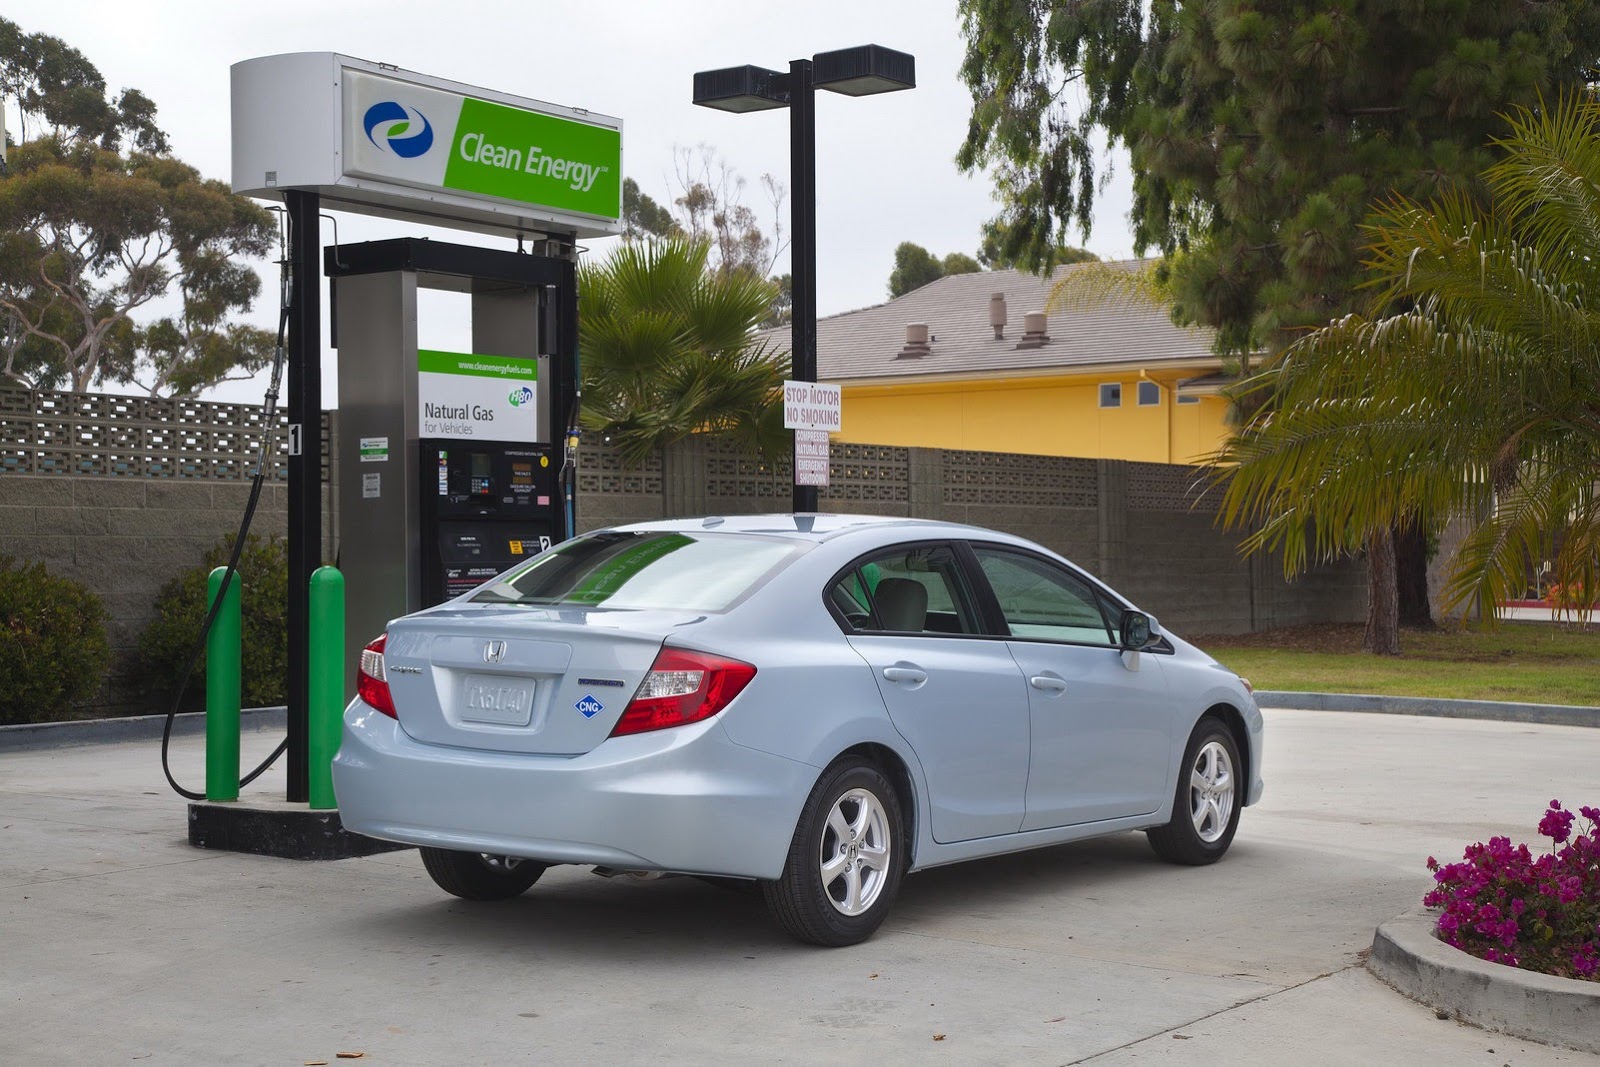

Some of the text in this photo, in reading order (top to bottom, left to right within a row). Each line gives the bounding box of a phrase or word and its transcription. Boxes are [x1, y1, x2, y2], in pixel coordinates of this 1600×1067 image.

[460, 132, 522, 171] Clean
[525, 146, 600, 192] Energy
[458, 362, 532, 375] www.cleanenergyfuels.com
[786, 386, 839, 406] STOP MOTOR
[425, 402, 494, 421] Natural Gas
[786, 407, 839, 426] NO SMOKING
[425, 420, 473, 435] for Vehicles
[291, 425, 299, 454] 1
[796, 430, 829, 442] COMPRESSED
[796, 443, 829, 456] NATURAL GAS
[798, 460, 827, 471] EMERGENCY
[799, 473, 827, 484] SHUTDOWN
[579, 701, 599, 713] CNG
